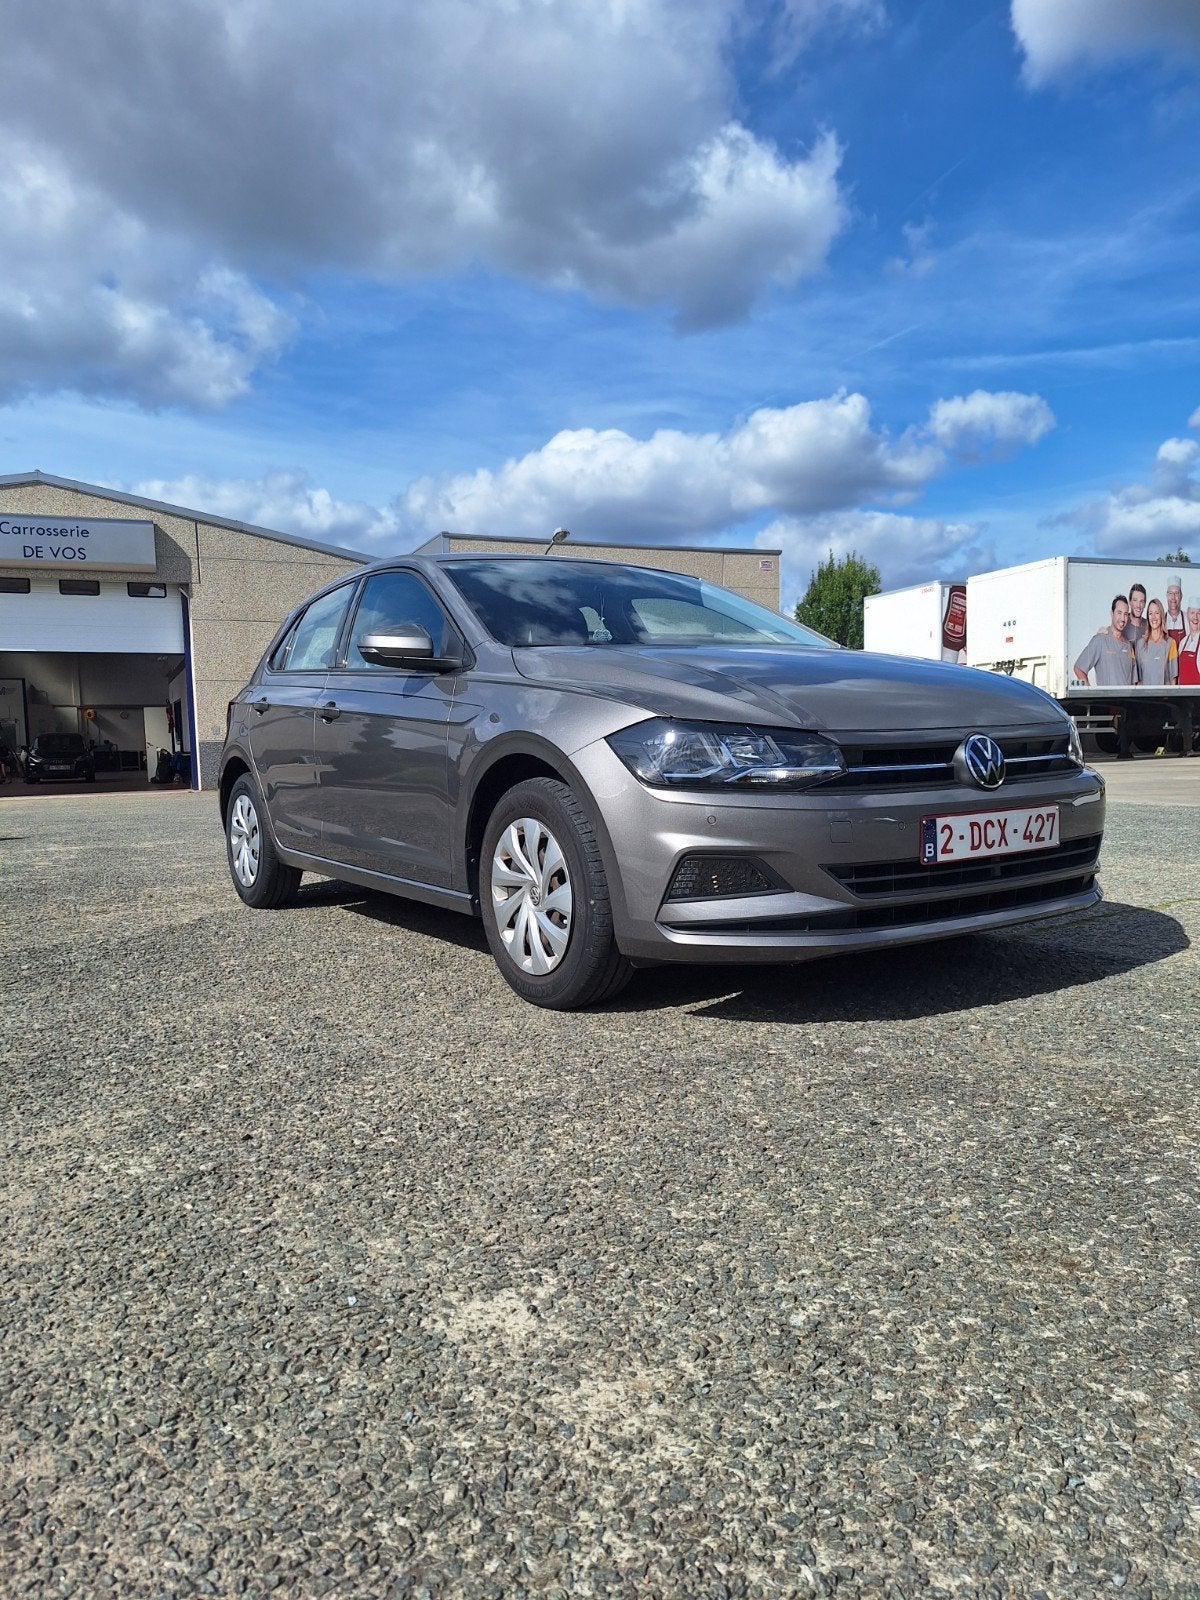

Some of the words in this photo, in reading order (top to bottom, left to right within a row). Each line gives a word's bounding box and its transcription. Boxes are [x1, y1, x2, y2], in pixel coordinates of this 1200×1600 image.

[0, 521, 90, 538] Carrosserie
[23, 545, 44, 559] DE
[50, 546, 87, 560] VOS
[925, 843, 934, 857] B
[940, 813, 1056, 854] 2-DCX-427
